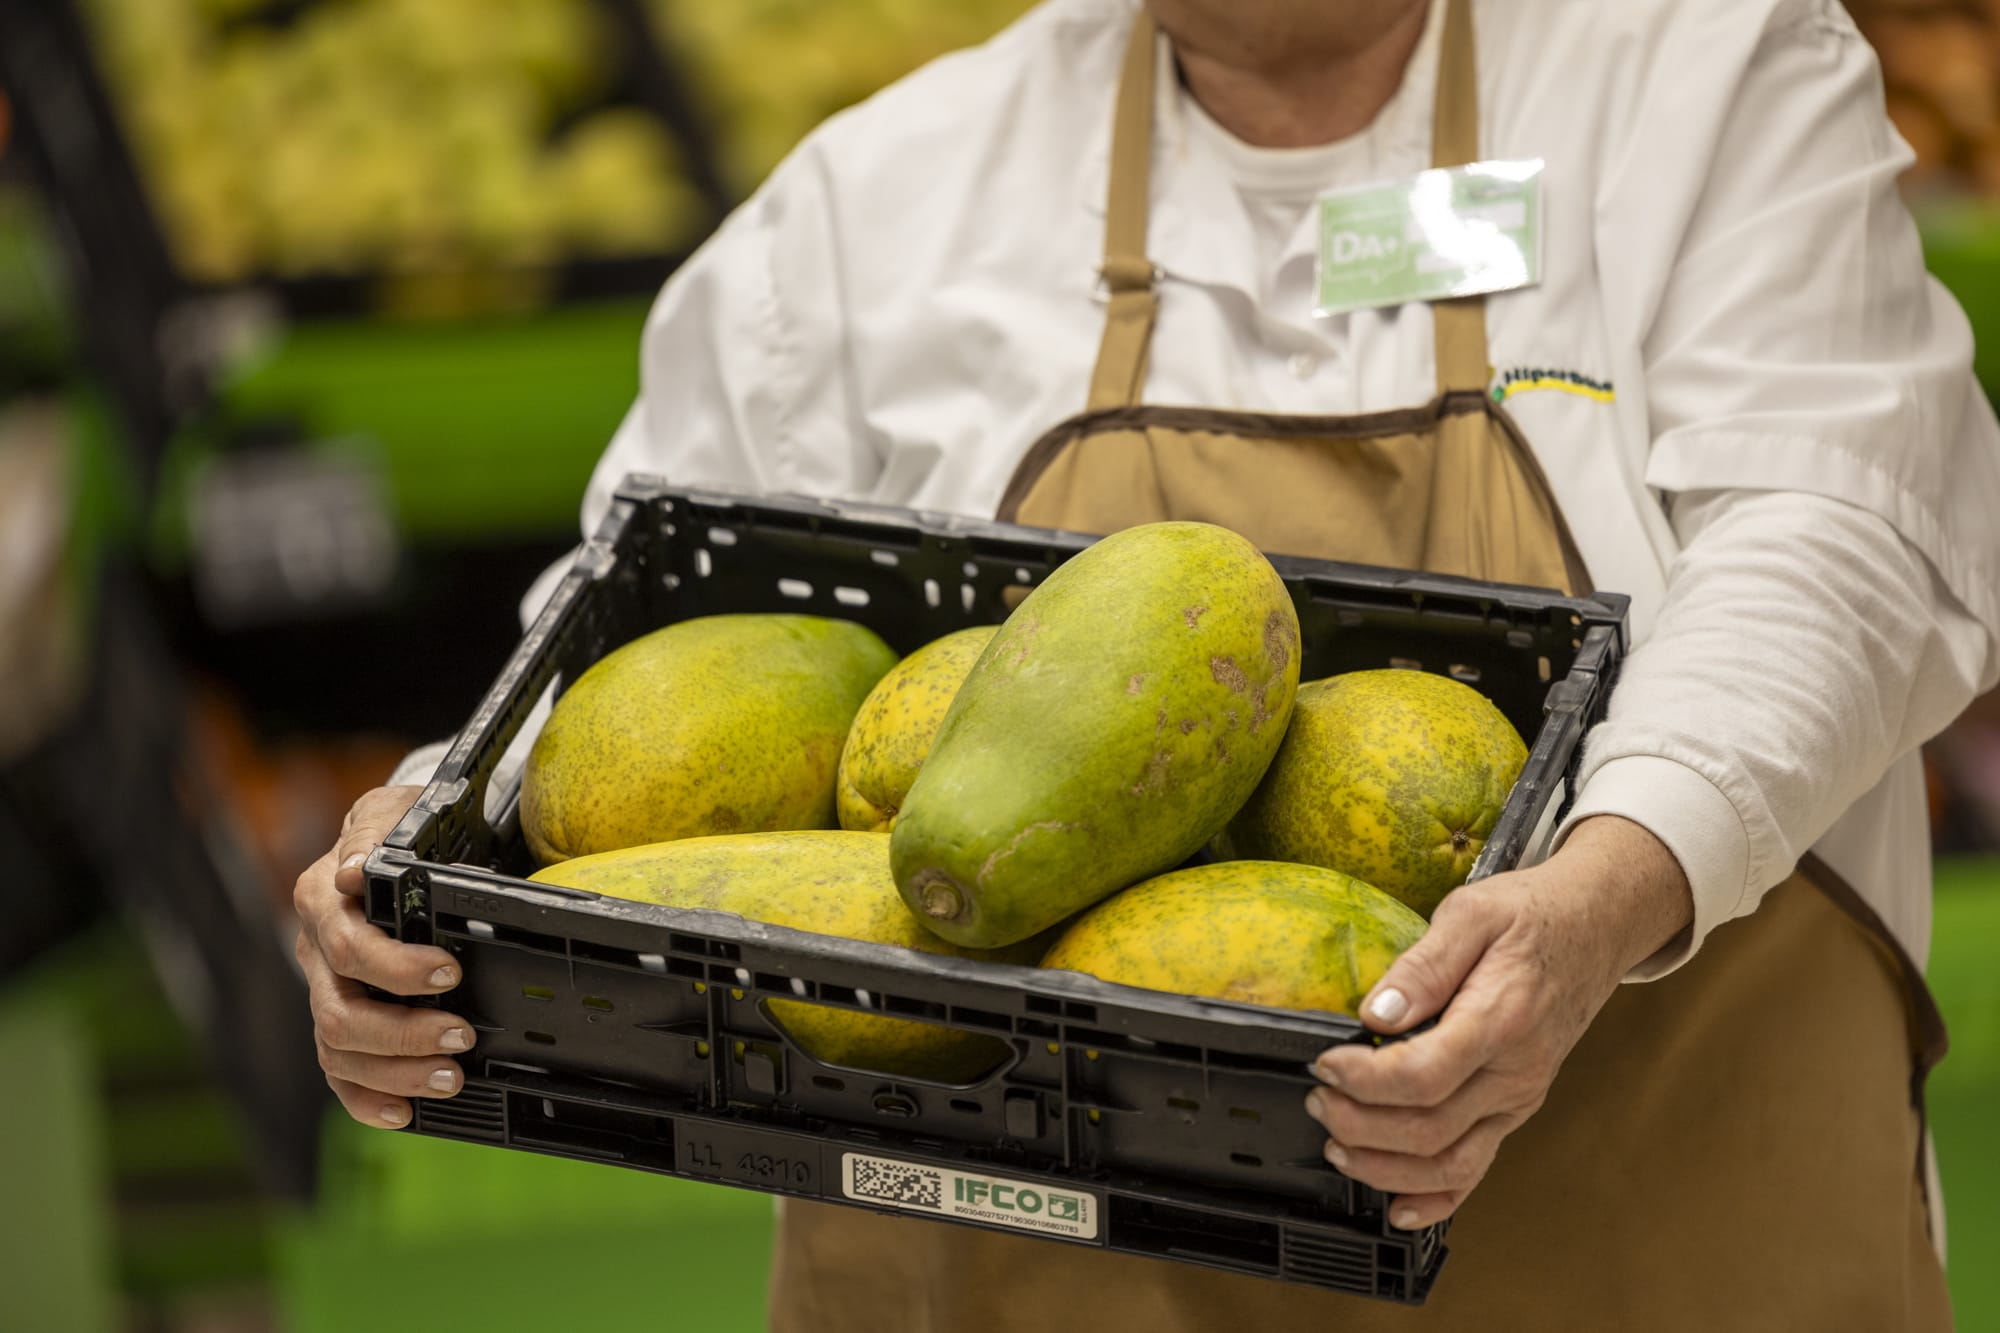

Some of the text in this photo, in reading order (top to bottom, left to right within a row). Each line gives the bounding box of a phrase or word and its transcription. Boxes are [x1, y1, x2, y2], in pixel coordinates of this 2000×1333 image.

[686, 1141, 811, 1184] LL 4310
[954, 1177, 1043, 1214] IFCO
